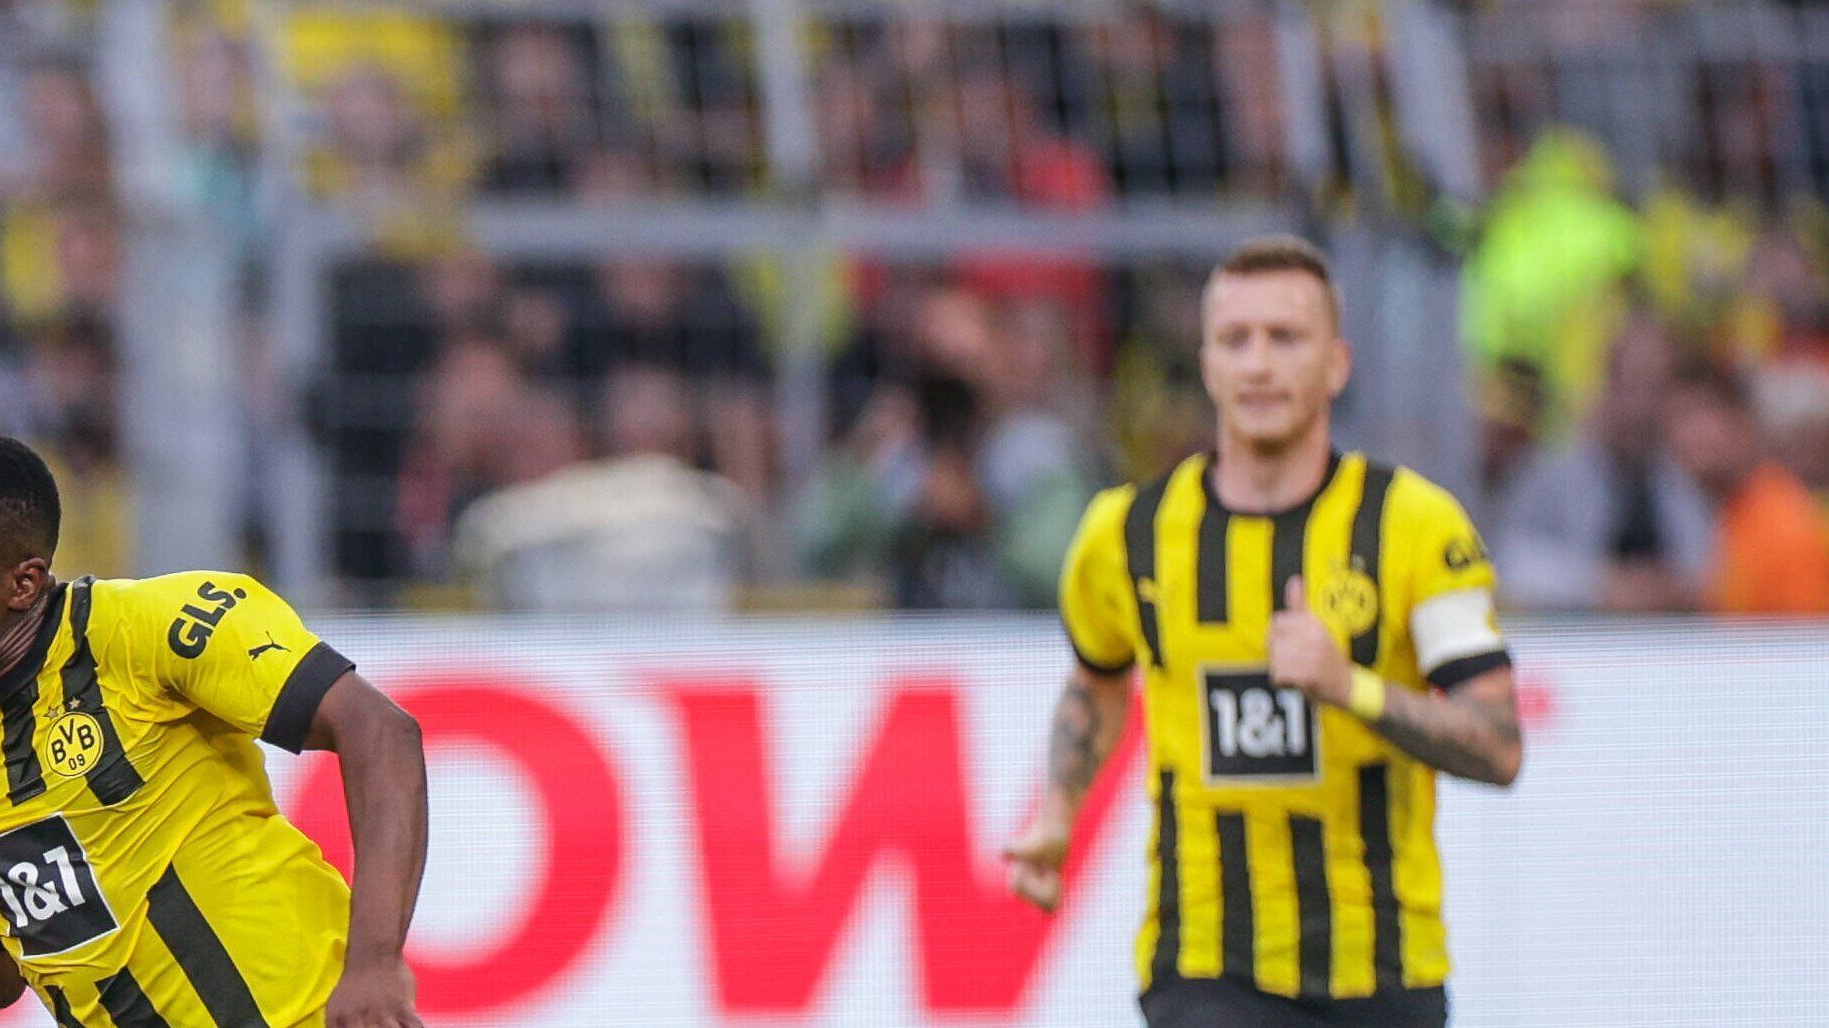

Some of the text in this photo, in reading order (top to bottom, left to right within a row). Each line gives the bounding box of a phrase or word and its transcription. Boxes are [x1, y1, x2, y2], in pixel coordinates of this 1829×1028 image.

[168, 580, 247, 660] GLS.
[51, 718, 95, 765] BVB
[1210, 687, 1307, 758] 1&1
[68, 753, 86, 771] 09
